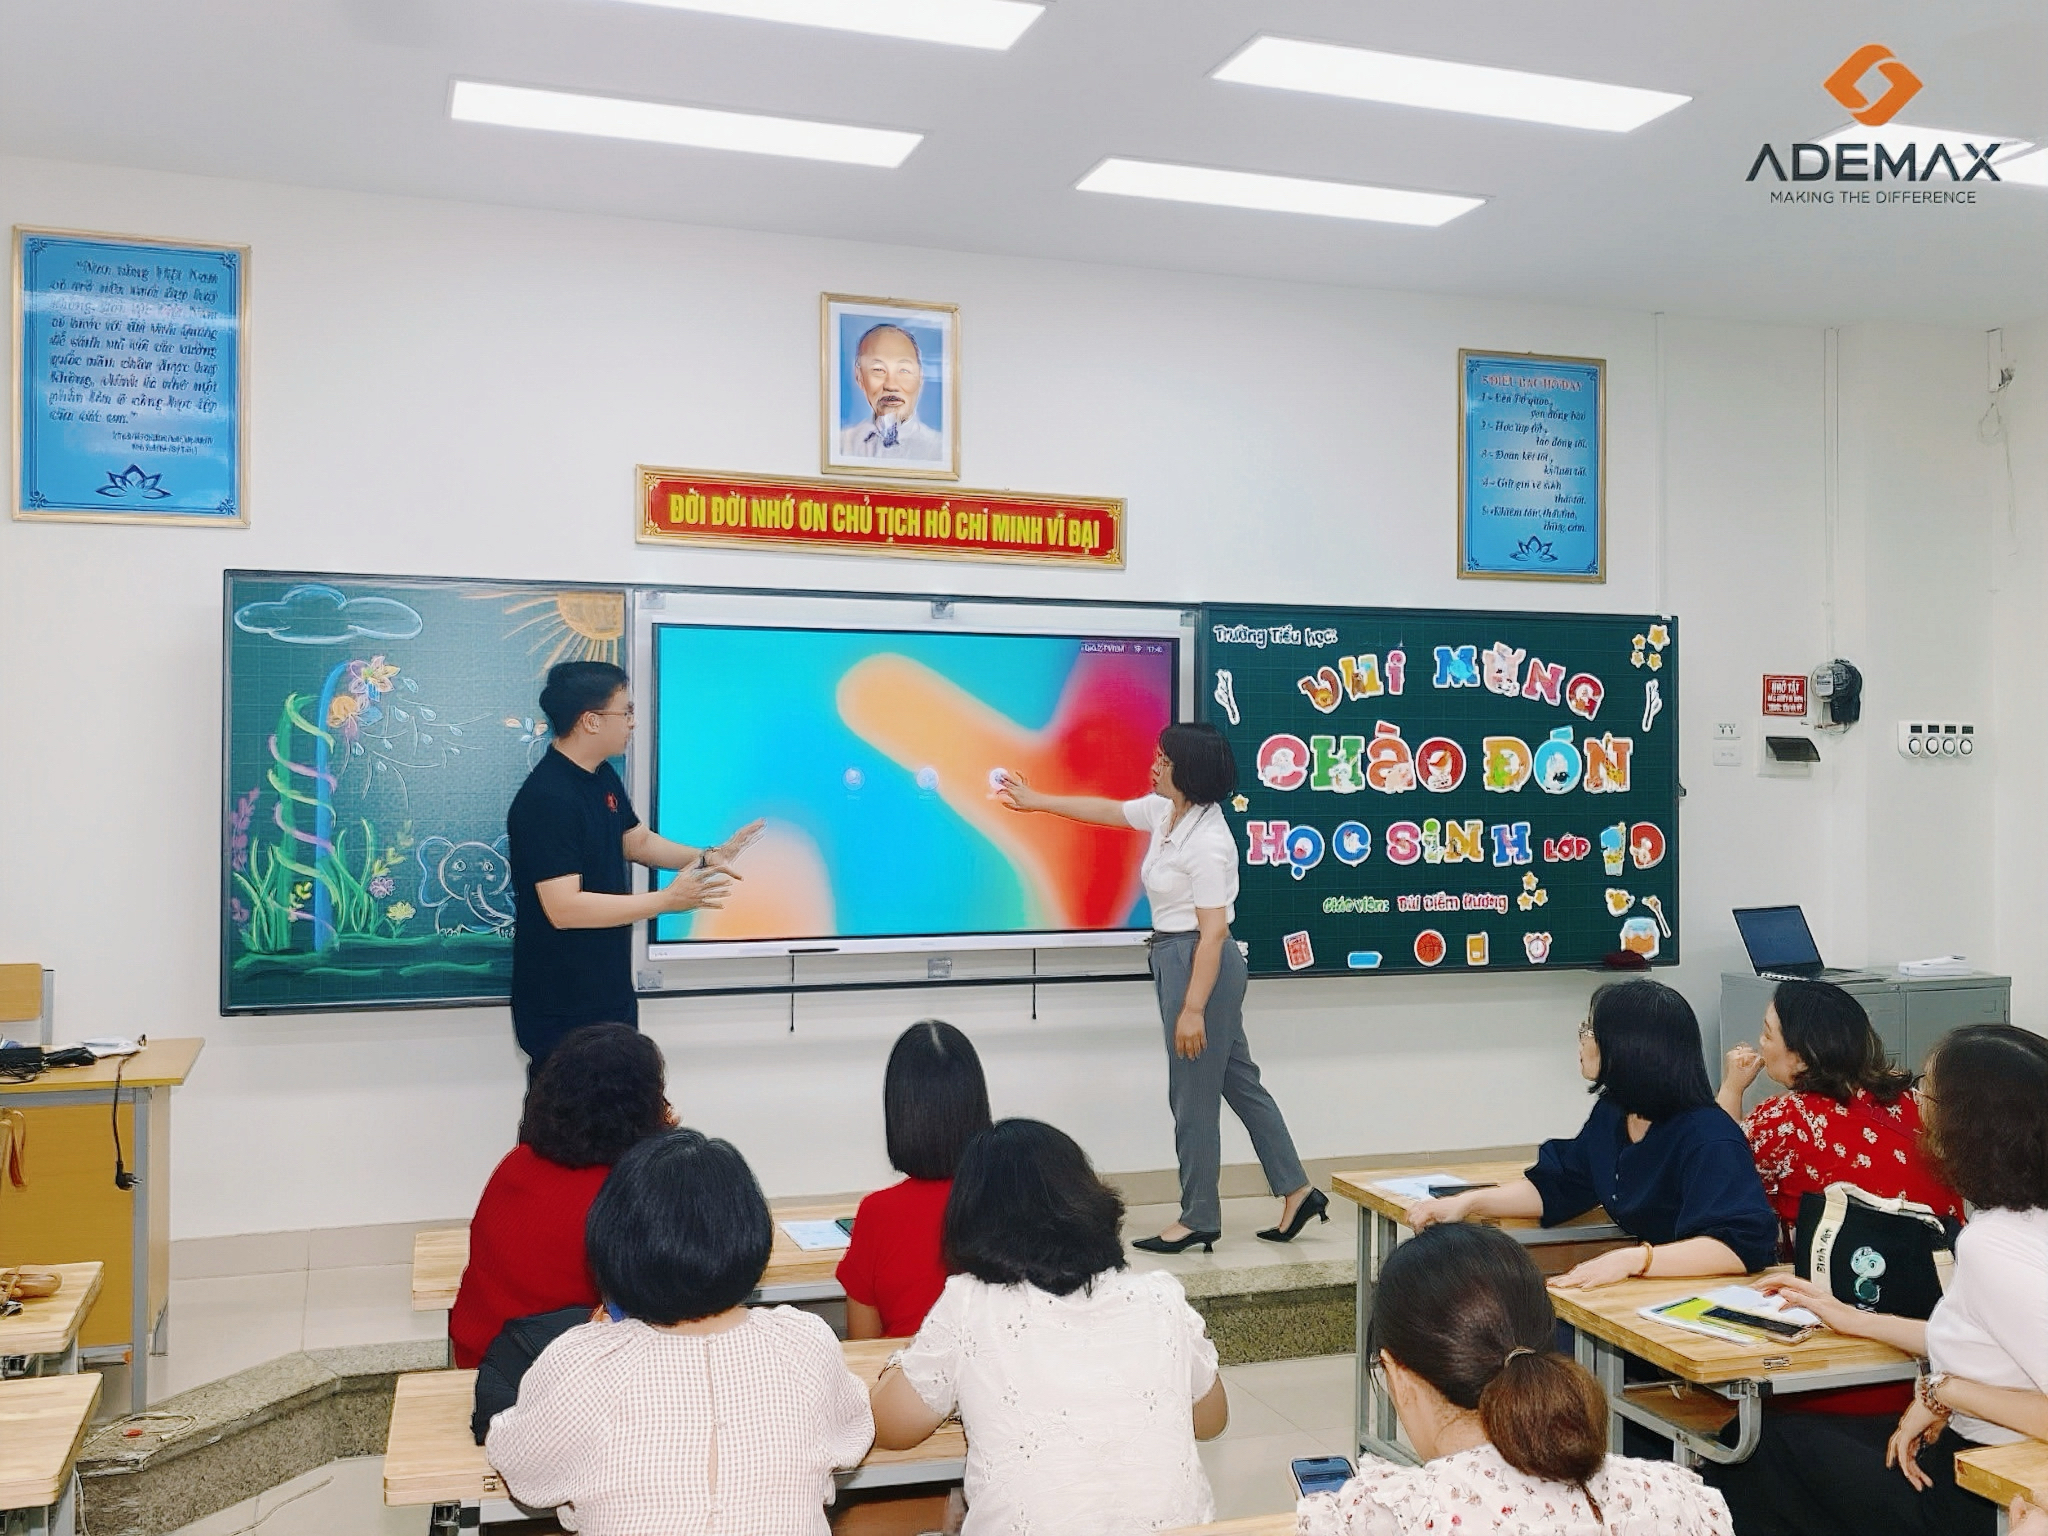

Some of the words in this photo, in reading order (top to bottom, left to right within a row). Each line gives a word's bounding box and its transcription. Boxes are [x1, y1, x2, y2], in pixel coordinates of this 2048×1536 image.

[670, 488, 706, 525] ĐỜI
[711, 490, 747, 528] ĐỜI
[751, 493, 796, 530] NHỚ
[799, 499, 828, 533] ƠN
[833, 495, 874, 535] CHỦ
[876, 506, 921, 543] TỊCH
[925, 501, 951, 539] HỒ
[955, 507, 988, 542] CHÍ
[992, 513, 1043, 545] MINH
[1047, 512, 1065, 547] VĨ
[1067, 519, 1100, 555] ĐẠI
[1213, 624, 1267, 649] Trường
[1269, 624, 1301, 645] Tiểu
[1544, 832, 1591, 862] LỚP
